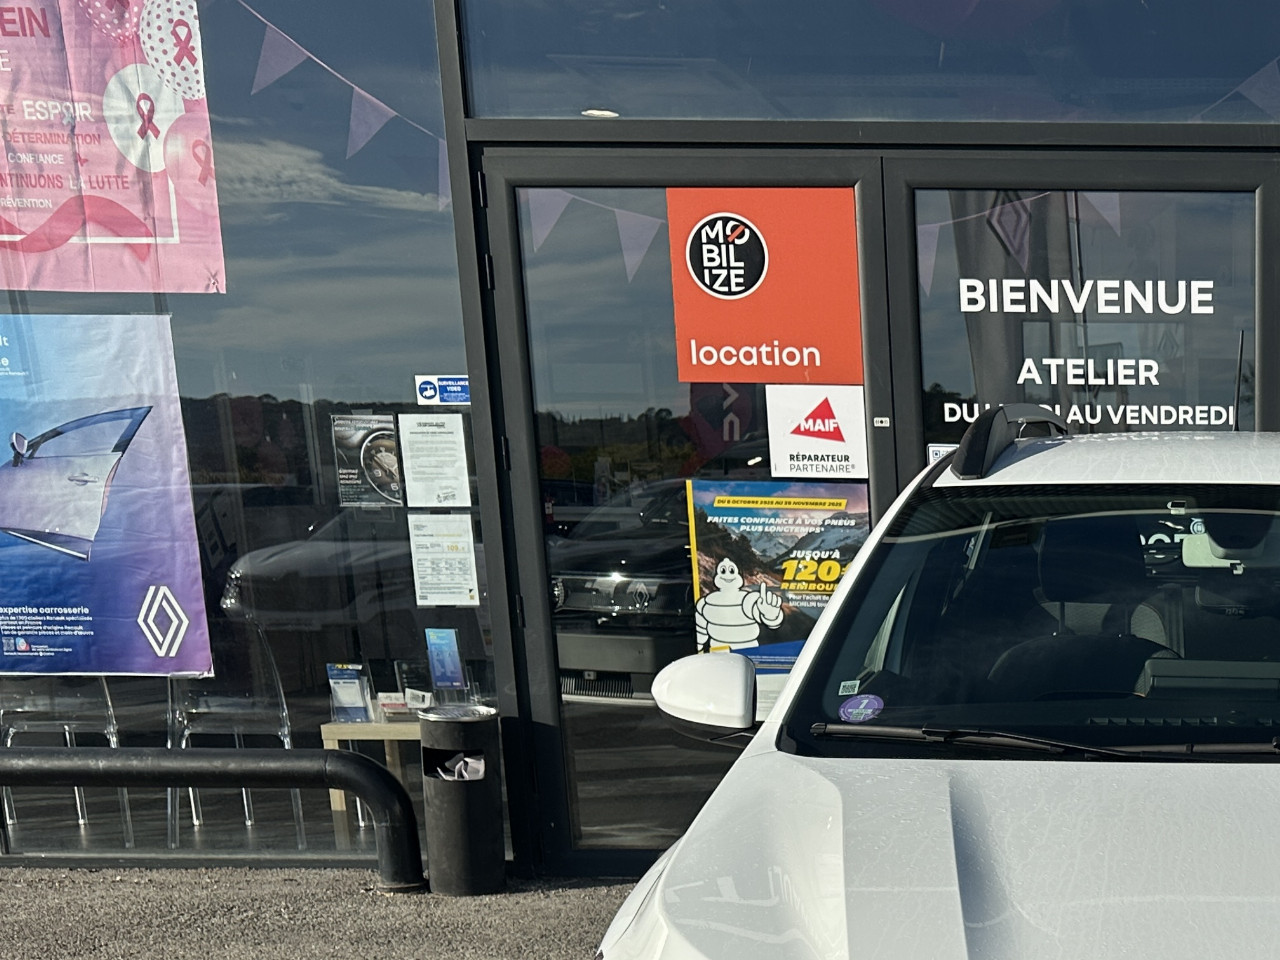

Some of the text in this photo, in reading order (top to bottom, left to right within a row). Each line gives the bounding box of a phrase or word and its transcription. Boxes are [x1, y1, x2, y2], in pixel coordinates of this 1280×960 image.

[22, 100, 95, 124] ESPOIR
[8, 152, 64, 165] CONFIANCE
[69, 175, 86, 190] LA
[88, 175, 130, 190] LUTTE
[958, 278, 1214, 314] BIENVENUE
[690, 339, 821, 367] location
[1016, 357, 1160, 386] ATELIER
[943, 402, 980, 424] DU
[1066, 403, 1102, 425] AU
[1107, 404, 1234, 425] VENDREDI
[800, 418, 838, 432] MAIF
[789, 451, 850, 462] RÉPARATEUR
[707, 516, 739, 524] FAITES
[741, 517, 794, 525] CONFIANCE
[804, 517, 823, 526] VOS
